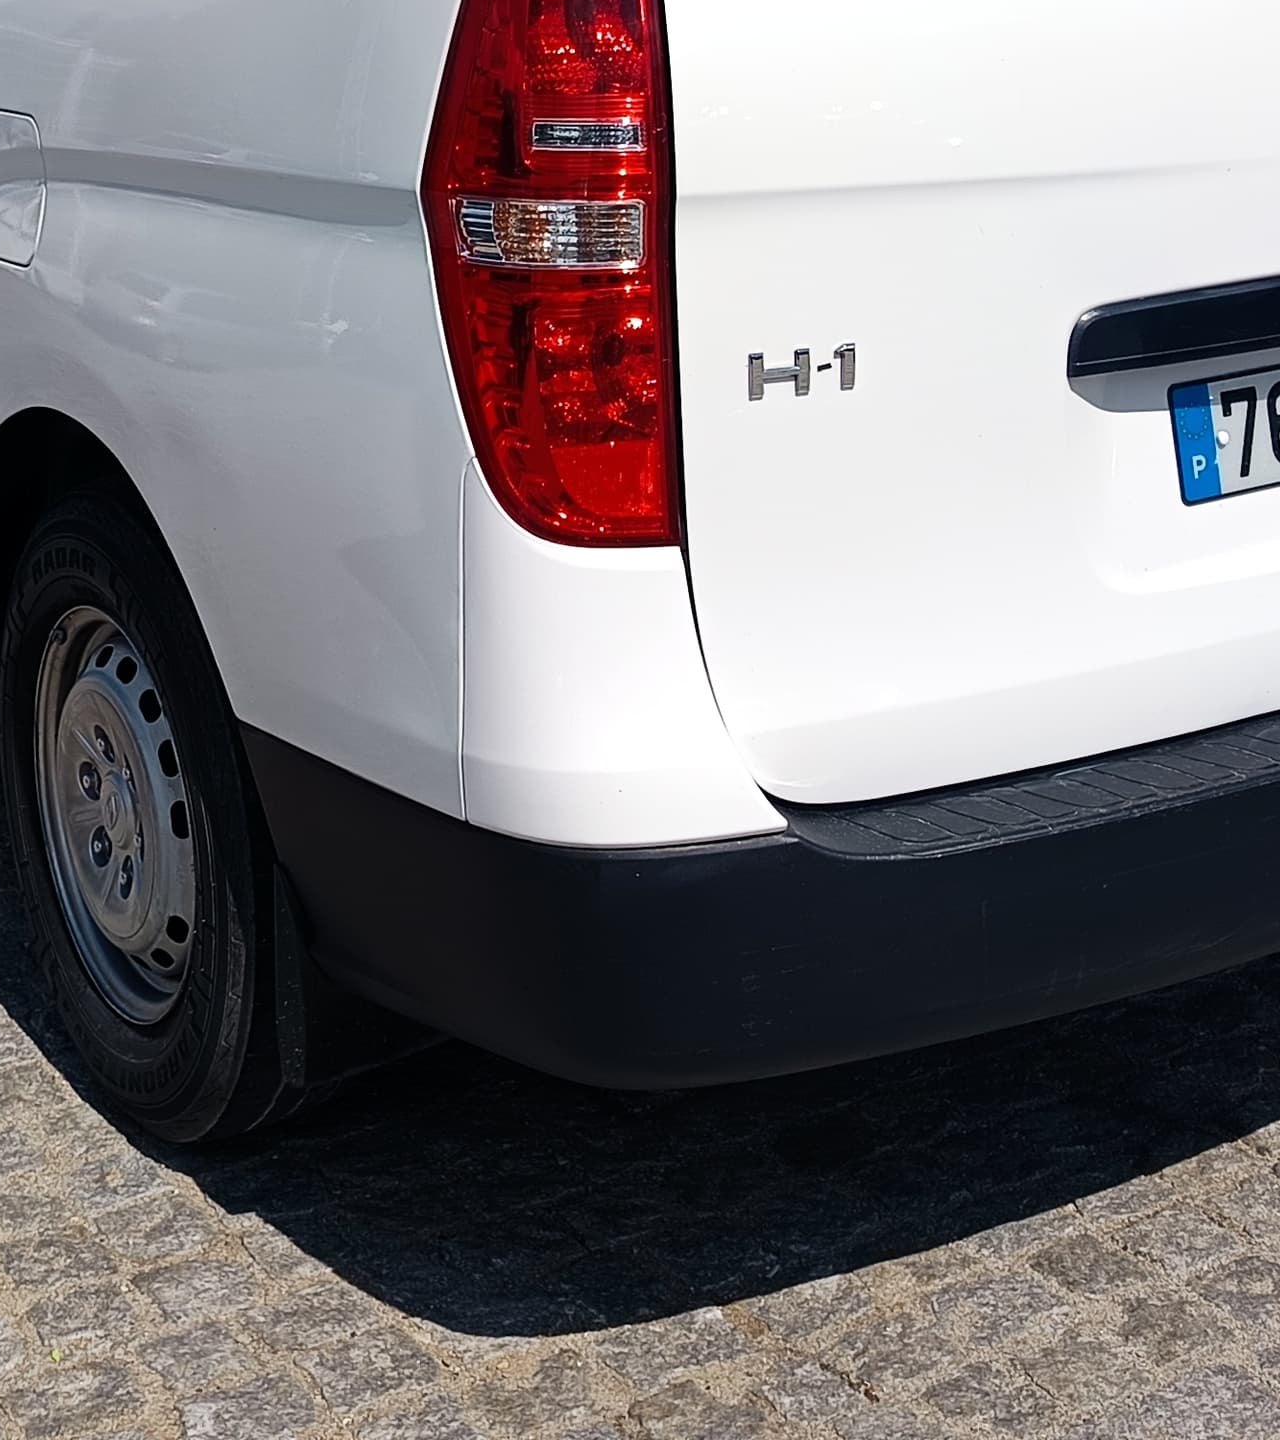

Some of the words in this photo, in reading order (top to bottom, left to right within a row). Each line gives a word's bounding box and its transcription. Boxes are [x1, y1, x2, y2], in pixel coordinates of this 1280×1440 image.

[748, 343, 856, 402] H-1
[1193, 455, 1207, 479] P
[30, 546, 96, 585] RADAR
